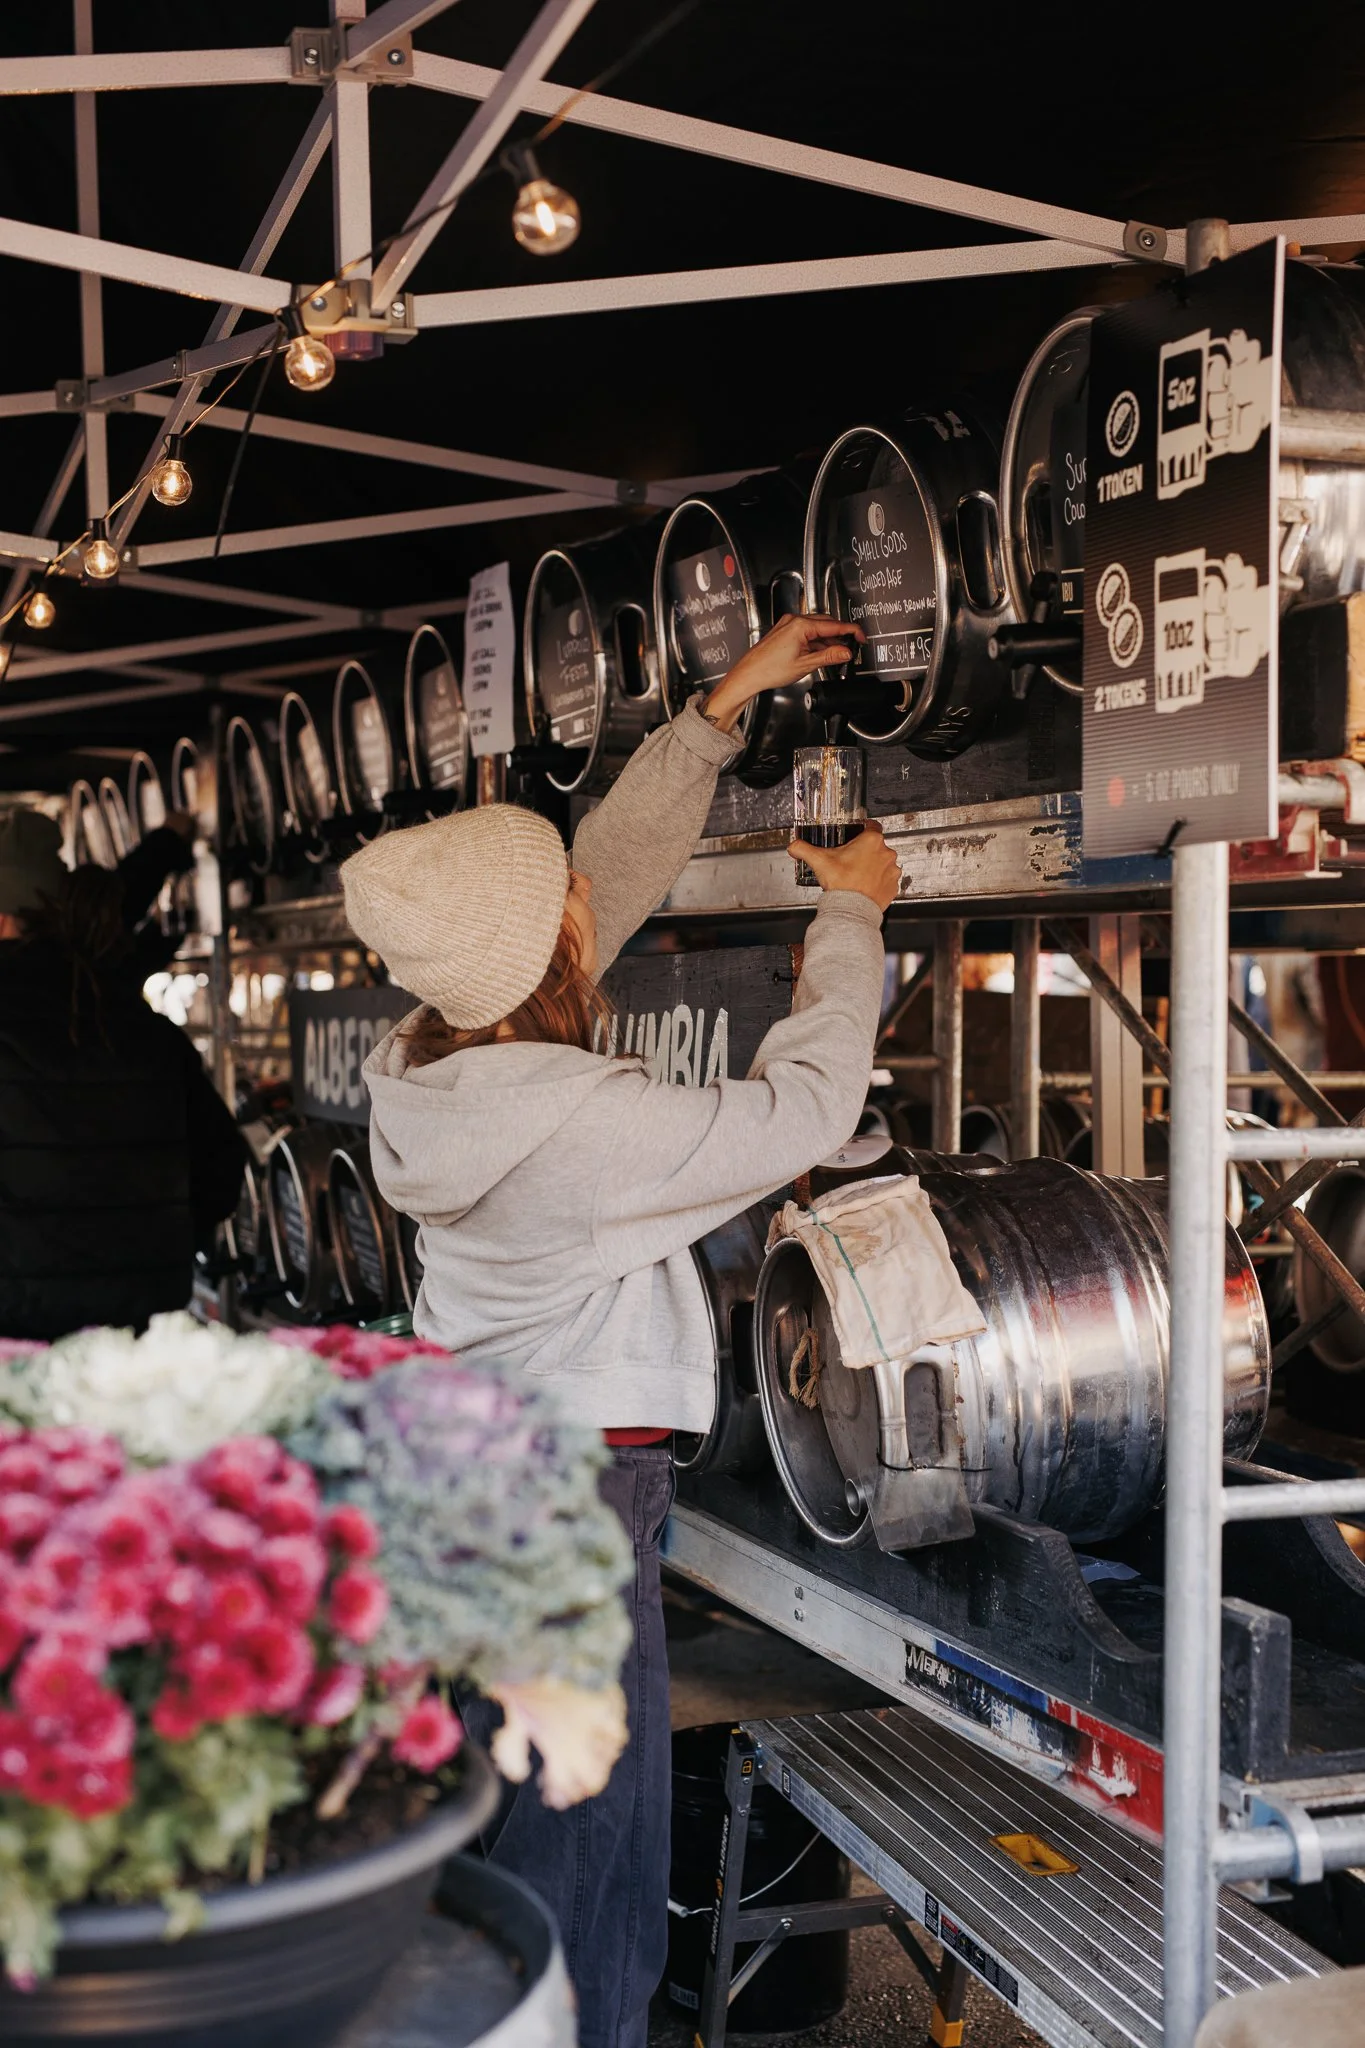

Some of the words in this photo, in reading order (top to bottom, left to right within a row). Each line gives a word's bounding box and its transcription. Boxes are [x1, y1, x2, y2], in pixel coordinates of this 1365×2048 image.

[1104, 463, 1143, 502] TOKEN
[852, 536, 880, 567] SMALL
[880, 531, 907, 558] GODS
[903, 597, 925, 613] BROWN
[1093, 685, 1105, 712] 2
